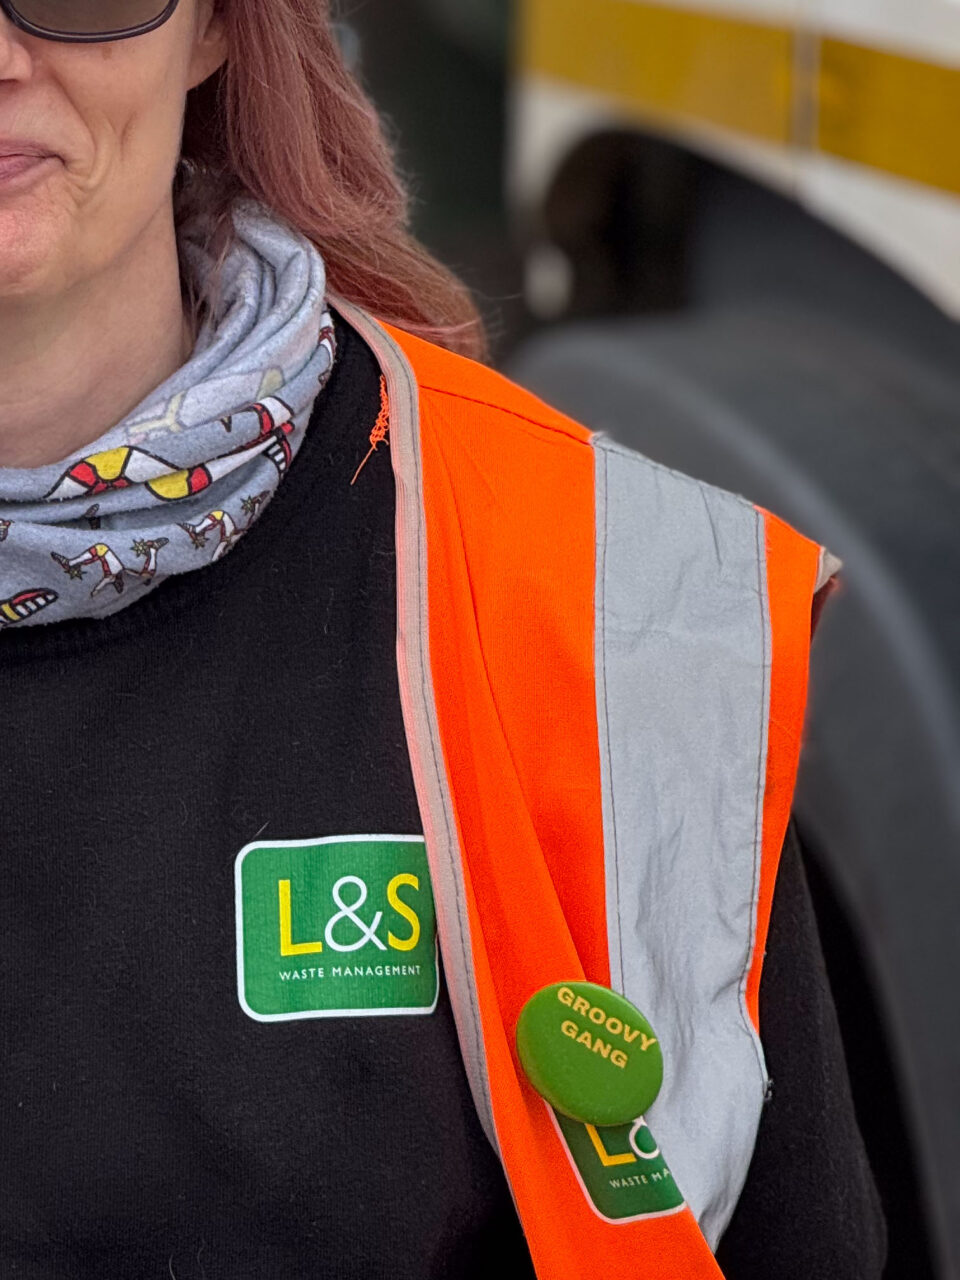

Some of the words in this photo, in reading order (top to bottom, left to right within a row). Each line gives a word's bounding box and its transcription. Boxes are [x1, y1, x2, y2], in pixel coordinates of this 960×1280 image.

[278, 873, 421, 956] L&S
[279, 967, 325, 981] WASTE
[332, 965, 421, 977] MANAGEMENT
[557, 986, 657, 1052] GROOVY
[560, 1020, 629, 1069] GANG
[609, 1174, 649, 1189] WASTE
